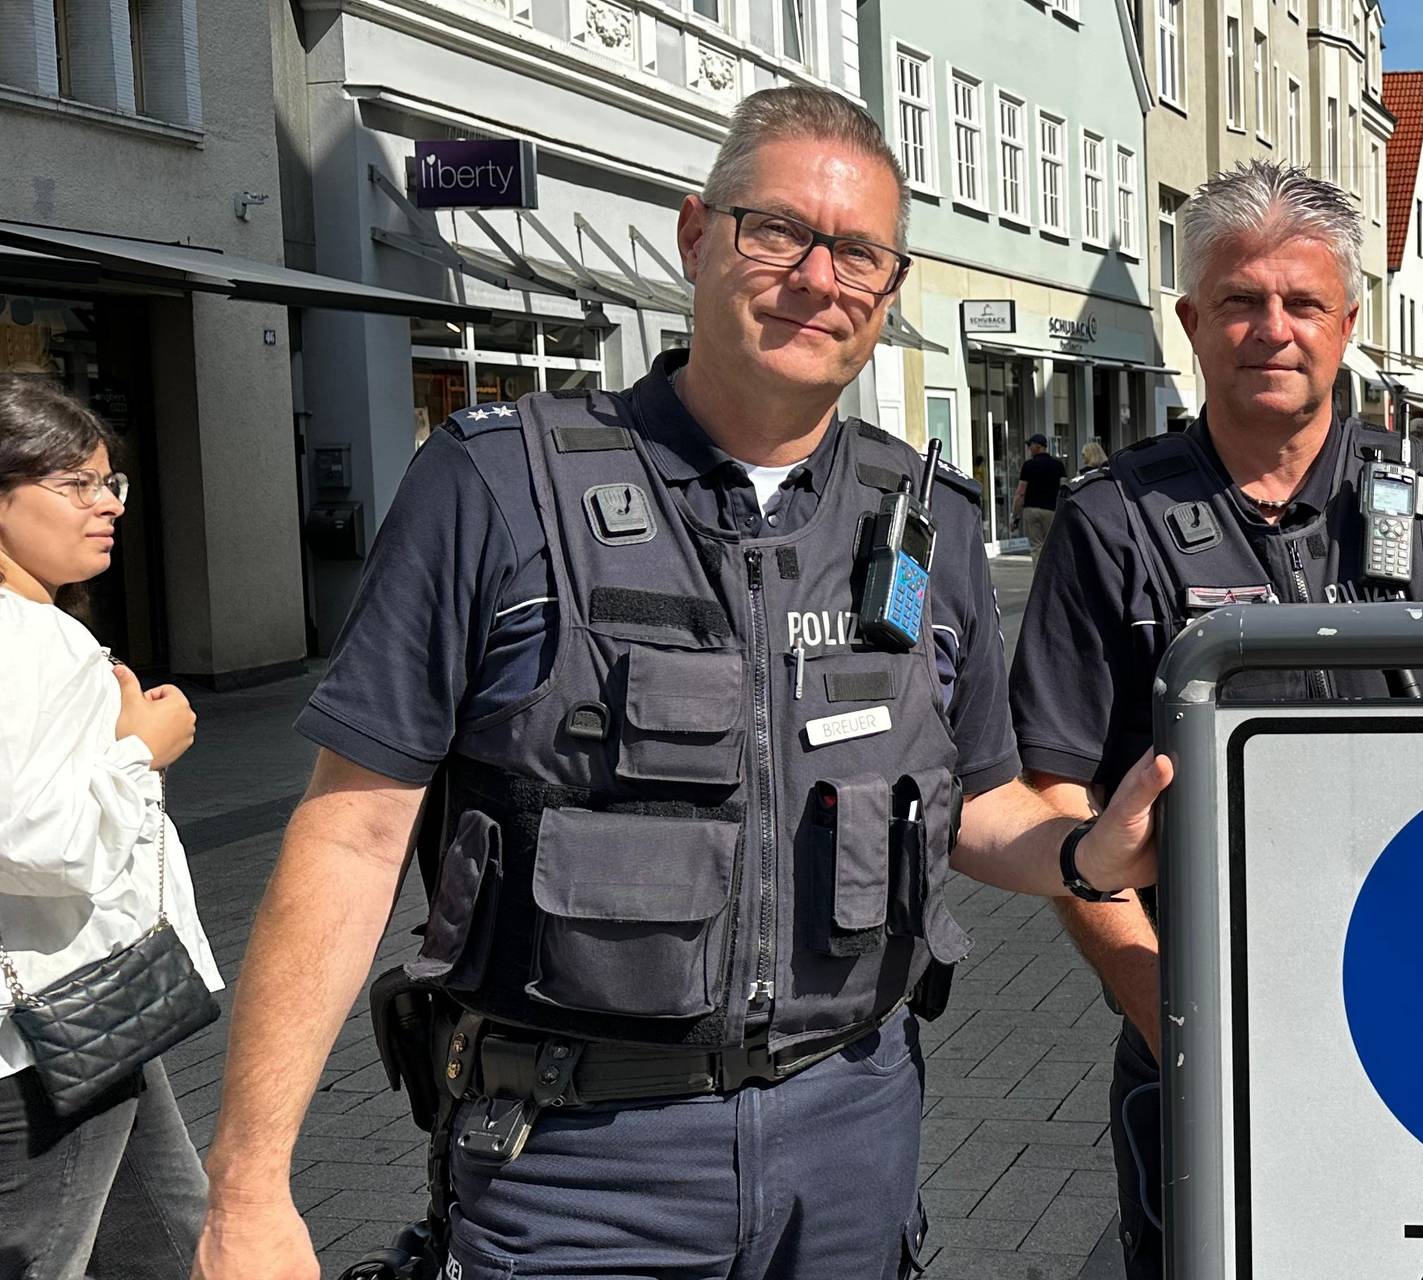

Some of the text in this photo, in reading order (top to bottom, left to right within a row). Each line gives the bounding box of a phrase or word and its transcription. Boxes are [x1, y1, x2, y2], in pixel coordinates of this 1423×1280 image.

[421, 154, 514, 194] liberty
[787, 611, 873, 646] POLIZ
[821, 713, 877, 738] BREUER
